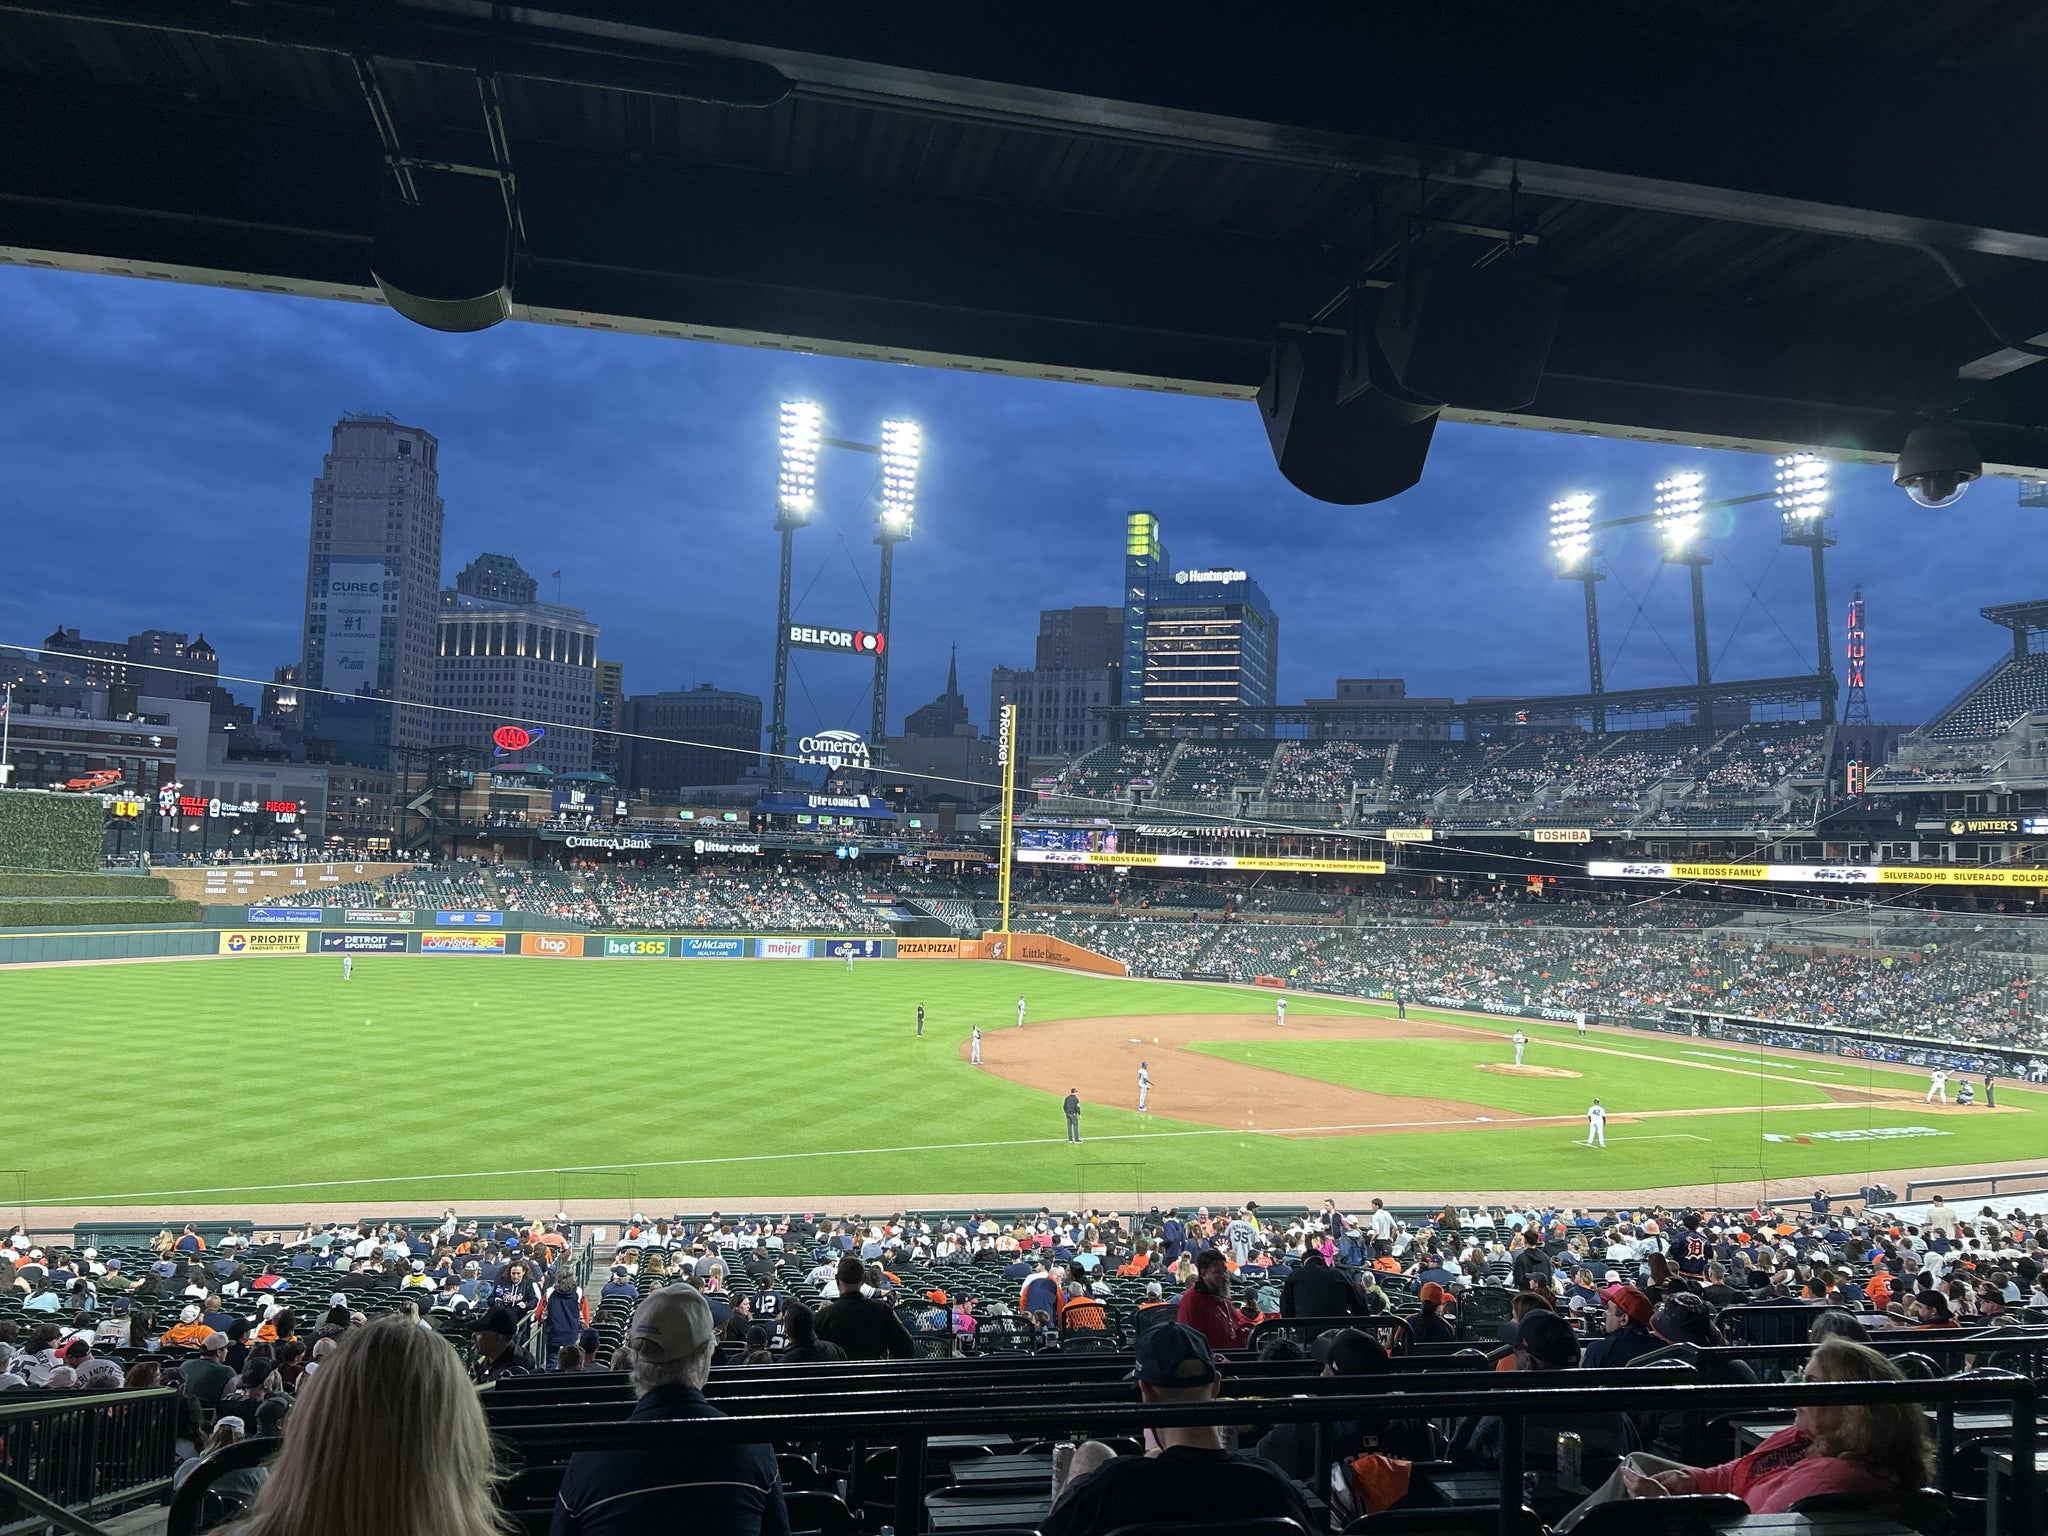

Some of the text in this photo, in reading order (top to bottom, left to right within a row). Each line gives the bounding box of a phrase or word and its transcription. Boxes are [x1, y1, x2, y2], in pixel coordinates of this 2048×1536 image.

[1189, 570, 1247, 585] Huntington
[332, 582, 368, 592] CURE
[344, 616, 361, 631] #1
[790, 627, 852, 647] BELFOR
[497, 727, 528, 749] AAA
[998, 718, 1010, 767] Rocket
[799, 755, 870, 769] LANDING
[180, 796, 209, 806] BELLE
[266, 801, 296, 812] FIEGER
[828, 797, 858, 807] LOUNGE
[182, 806, 204, 816] TIRE
[275, 812, 296, 823] LAW
[1967, 820, 2018, 832] WINTER'S
[1196, 827, 1251, 838] TIGER CLUB
[1537, 831, 1587, 840] TOSHIBA
[622, 838, 652, 849] Bank
[1110, 855, 1130, 863] BOSS
[1131, 856, 1157, 864] FAMILY
[295, 868, 303, 878] 10
[326, 865, 333, 875] 11
[355, 865, 363, 874] 42
[1676, 867, 1762, 877] TRAIL BOSS FAMILY
[1884, 871, 1932, 880] SILVERADO
[1934, 872, 1947, 880] HD
[1954, 873, 2004, 882] SILVERADO
[250, 935, 301, 944] PRIORITY
[428, 936, 474, 949] Surfside
[541, 937, 565, 953] hap
[701, 940, 737, 950] McLaren
[608, 940, 666, 954] bet365
[768, 942, 801, 955] meijer
[898, 944, 927, 953] PIZZA!
[928, 944, 956, 953] PIZZA!
[1022, 947, 1045, 958] Little
[1369, 989, 1394, 1000] bet365
[1592, 1109, 1601, 1117] 42
[1234, 1230, 1249, 1244] 35
[74, 1365, 115, 1389] ERLANDER
